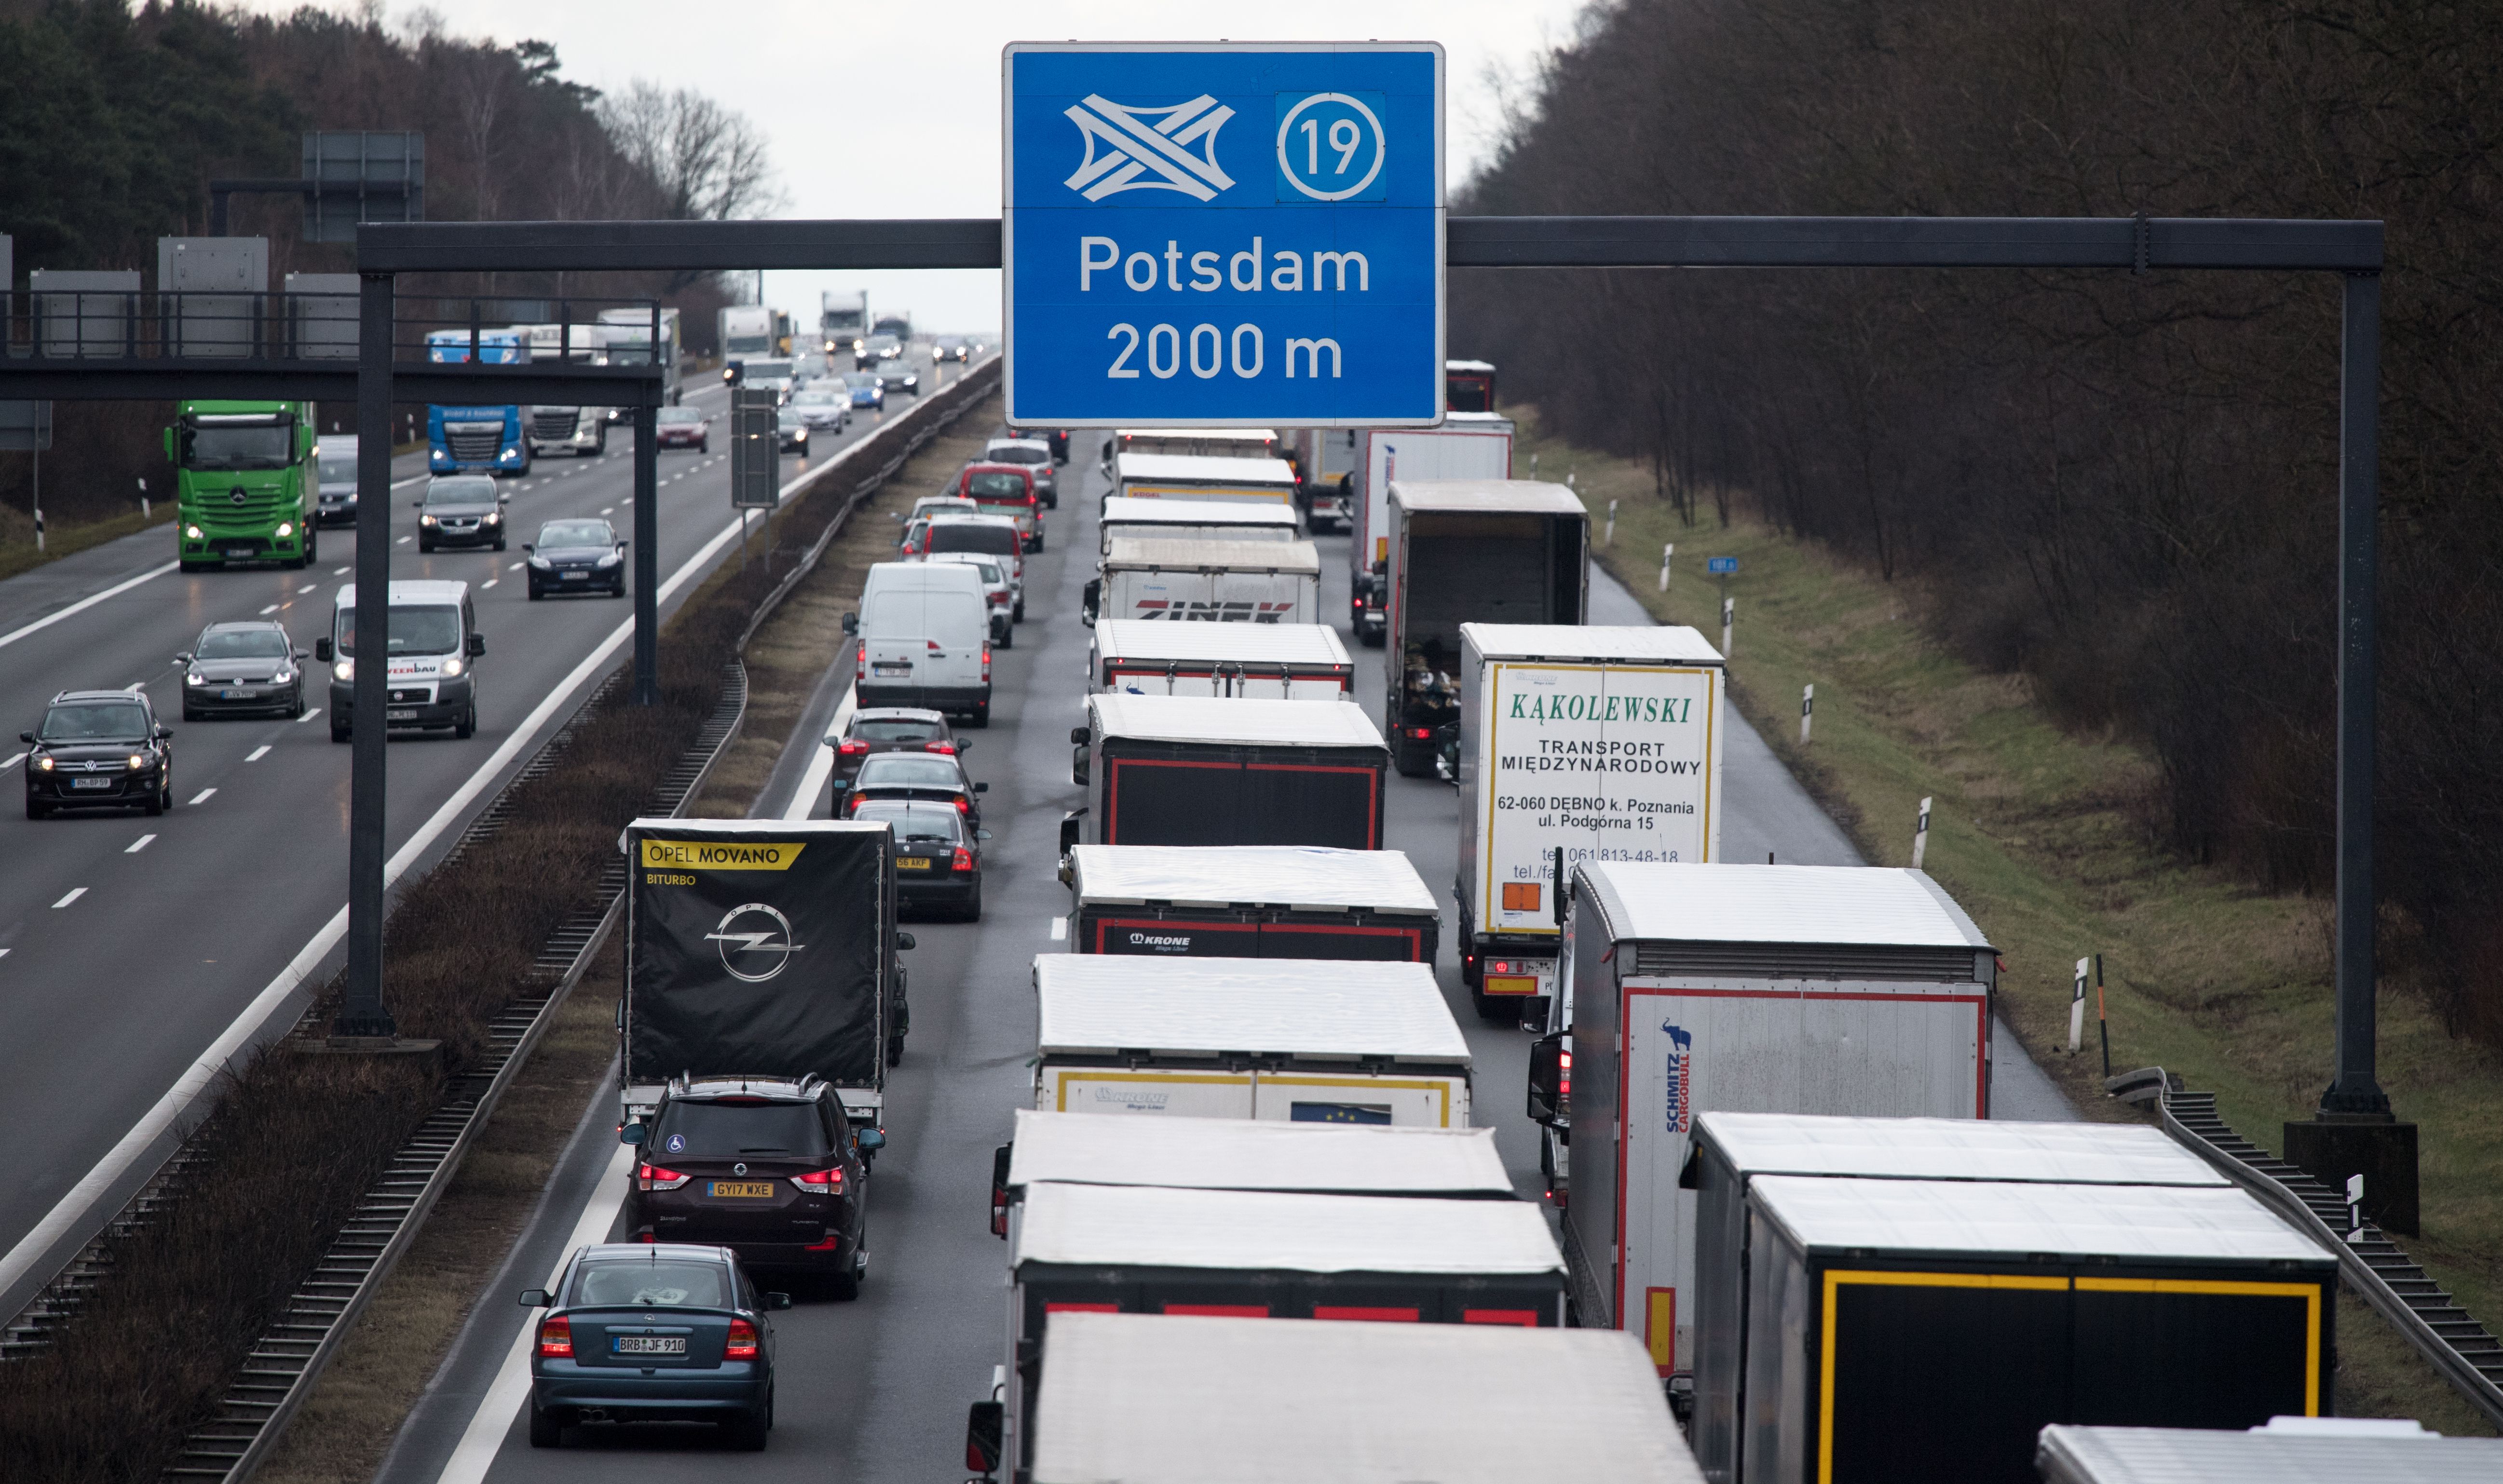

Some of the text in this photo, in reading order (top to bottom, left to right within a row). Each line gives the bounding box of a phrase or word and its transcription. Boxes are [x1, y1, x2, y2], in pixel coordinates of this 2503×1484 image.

[1300, 119, 1360, 175] 19
[1081, 236, 1369, 292] Potsdam
[1107, 323, 1342, 379] 2000 m
[1510, 694, 1692, 725] KĄKOLEWSKI
[1539, 740, 1665, 757] TRANSPORT
[1501, 755, 1701, 775] MIĘDZYNARODOWY
[1498, 796, 1694, 814] 62-060 DĘBNO k. Poznania
[1538, 814, 1654, 831] ul. Podgórna 15
[650, 846, 780, 863] OPEL MOVANO
[911, 858, 926, 866] AKF
[1569, 848, 1595, 862] 061
[1601, 849, 1678, 863] 813-48-18
[647, 874, 696, 885] BITURBO
[731, 904, 780, 917] OPEL
[1144, 936, 1191, 945] KRONE
[1114, 1092, 1170, 1103] KRONE
[1667, 1053, 1680, 1133] SCHMITZ
[1679, 1054, 1689, 1133] CARGOBULL
[718, 1184, 743, 1195] GY17
[747, 1185, 769, 1195] WXE
[620, 1339, 684, 1351] BRB JF 910
